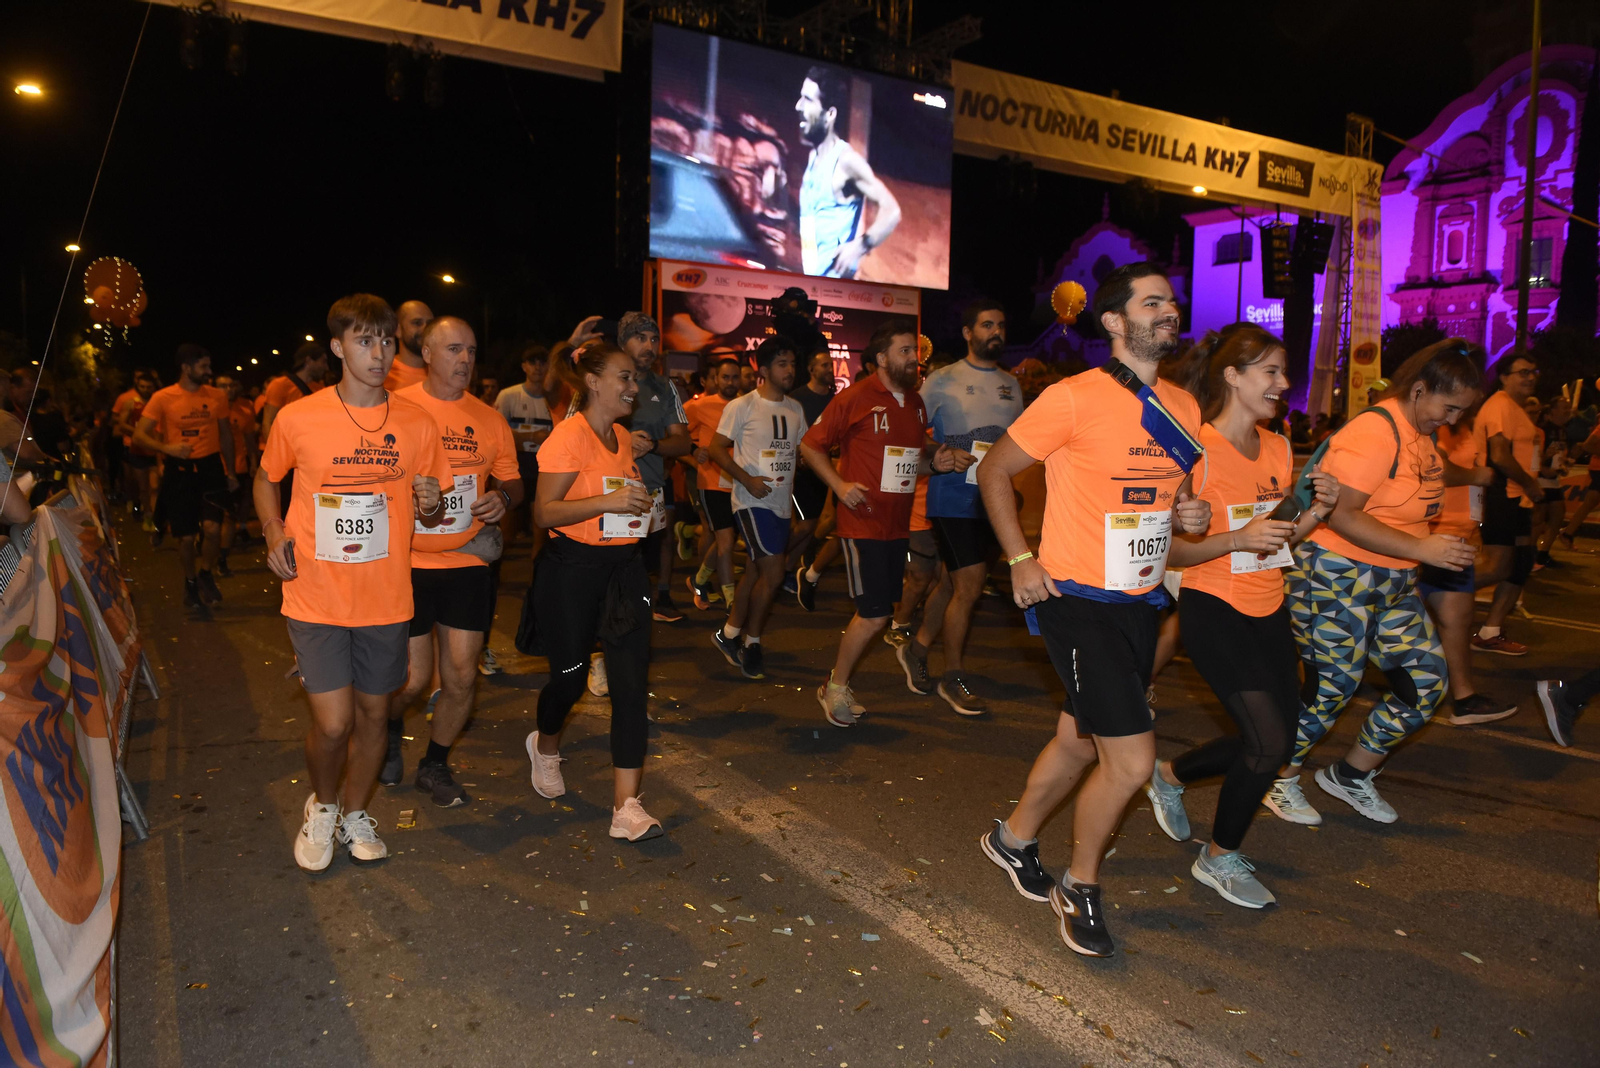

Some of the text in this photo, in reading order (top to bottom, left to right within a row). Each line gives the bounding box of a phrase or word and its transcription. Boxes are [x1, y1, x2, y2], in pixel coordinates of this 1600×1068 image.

[959, 88, 1100, 146] NOCTURNA
[1106, 123, 1198, 167] SEVILLA
[737, 280, 769, 290] Cruzcampo
[873, 413, 890, 434] 14
[441, 436, 479, 446] NOCTURNA
[769, 441, 791, 450] ARUS
[353, 448, 400, 458] NOCTURNA
[1128, 447, 1164, 458] SEVILLA
[332, 456, 374, 465] SEVILLA
[335, 518, 374, 535] 6383
[1127, 535, 1168, 557] 10673
